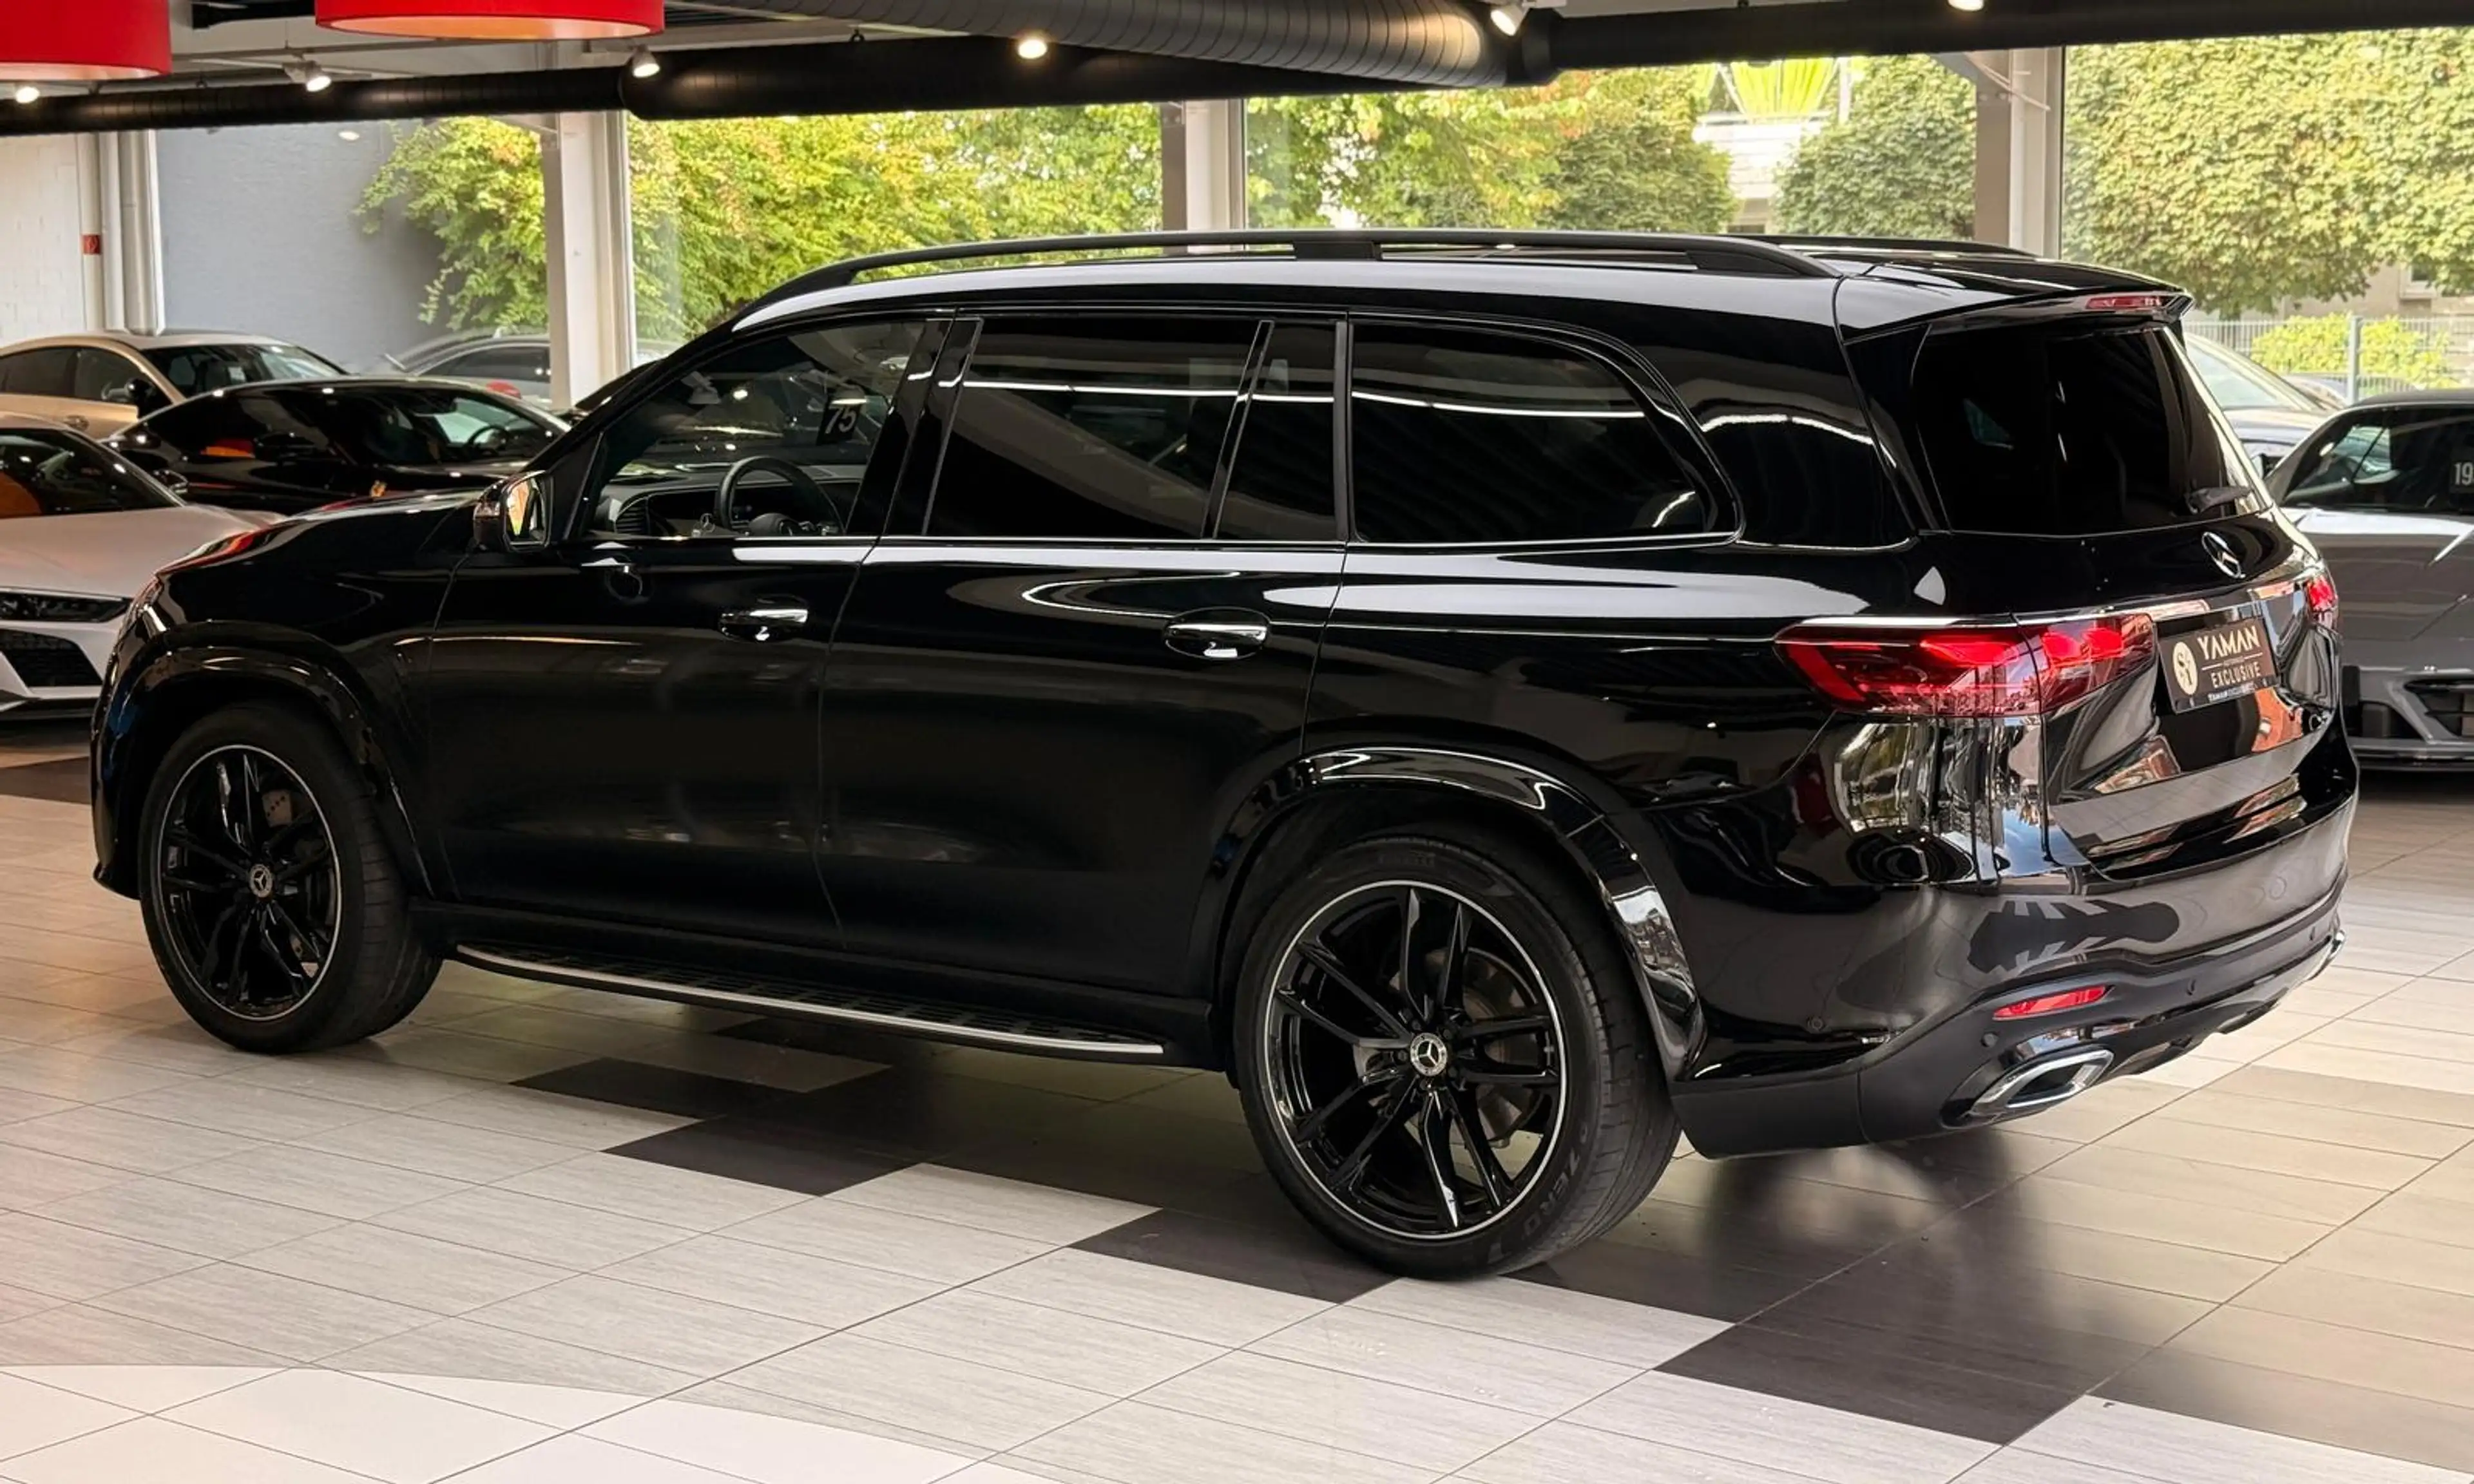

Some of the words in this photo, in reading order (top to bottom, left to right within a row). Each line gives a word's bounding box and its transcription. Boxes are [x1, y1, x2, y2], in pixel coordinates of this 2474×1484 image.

[825, 405, 857, 434] 75
[2453, 461, 2474, 486] 19
[2197, 625, 2261, 660] YAMAN
[2210, 661, 2261, 689] EXCLUSIVE
